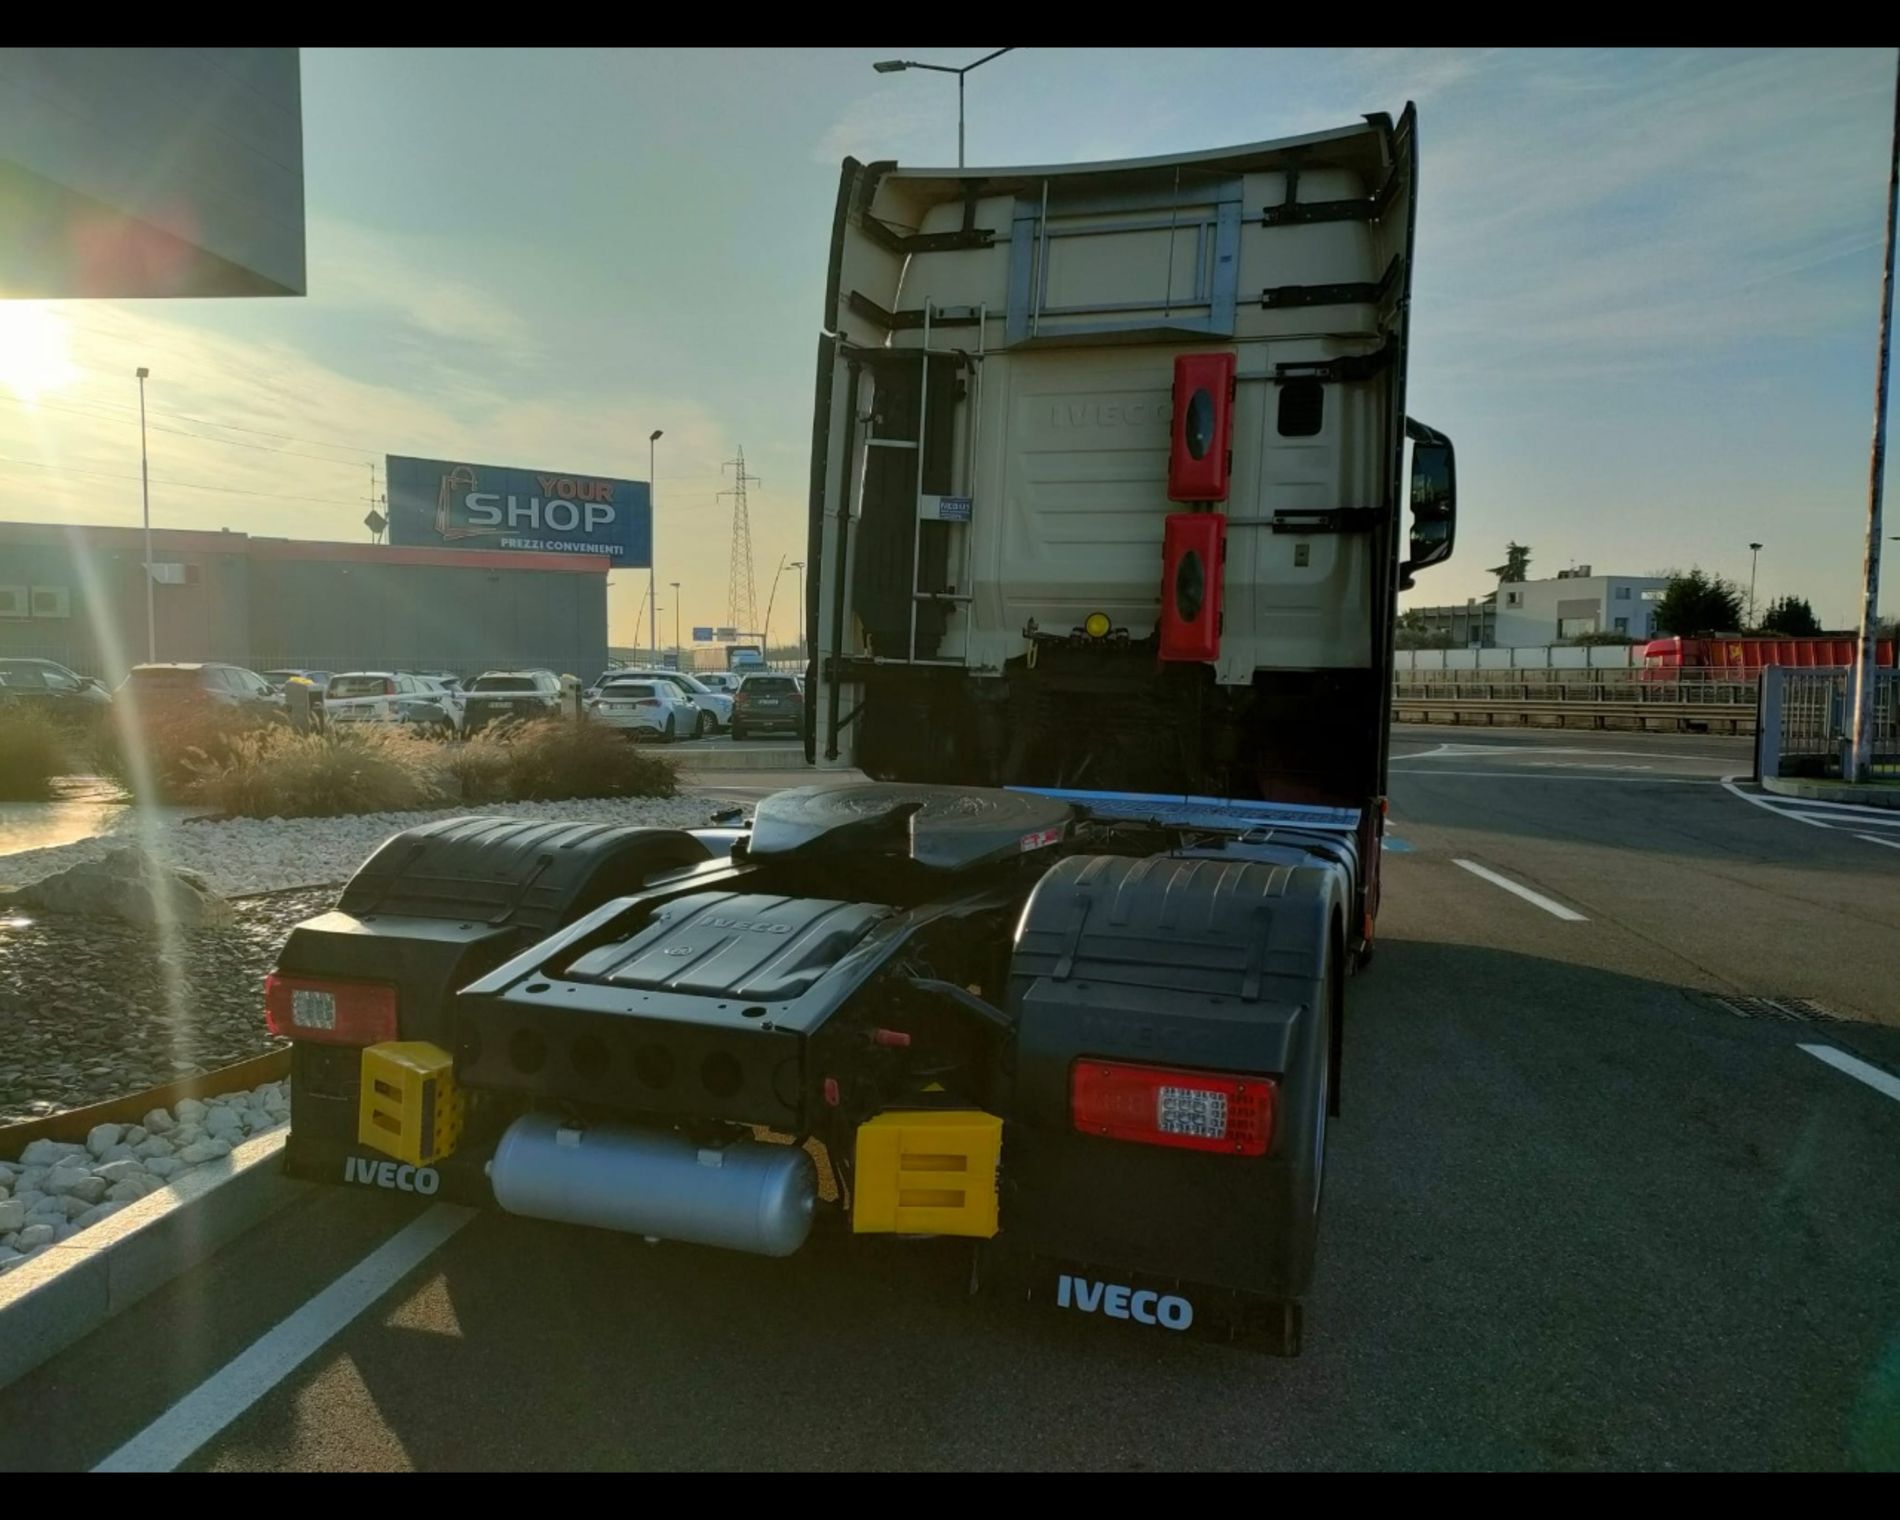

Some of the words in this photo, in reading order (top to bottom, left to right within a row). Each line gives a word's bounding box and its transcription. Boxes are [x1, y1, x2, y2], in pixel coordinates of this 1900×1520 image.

[538, 475, 614, 501] YOUR
[465, 493, 616, 532] SHOP
[501, 538, 543, 549] PREZZI
[546, 541, 624, 554] CONVENIENTI
[701, 917, 793, 935] IVECO
[344, 1156, 440, 1195] IVECO
[1057, 1274, 1193, 1331] IVECO
